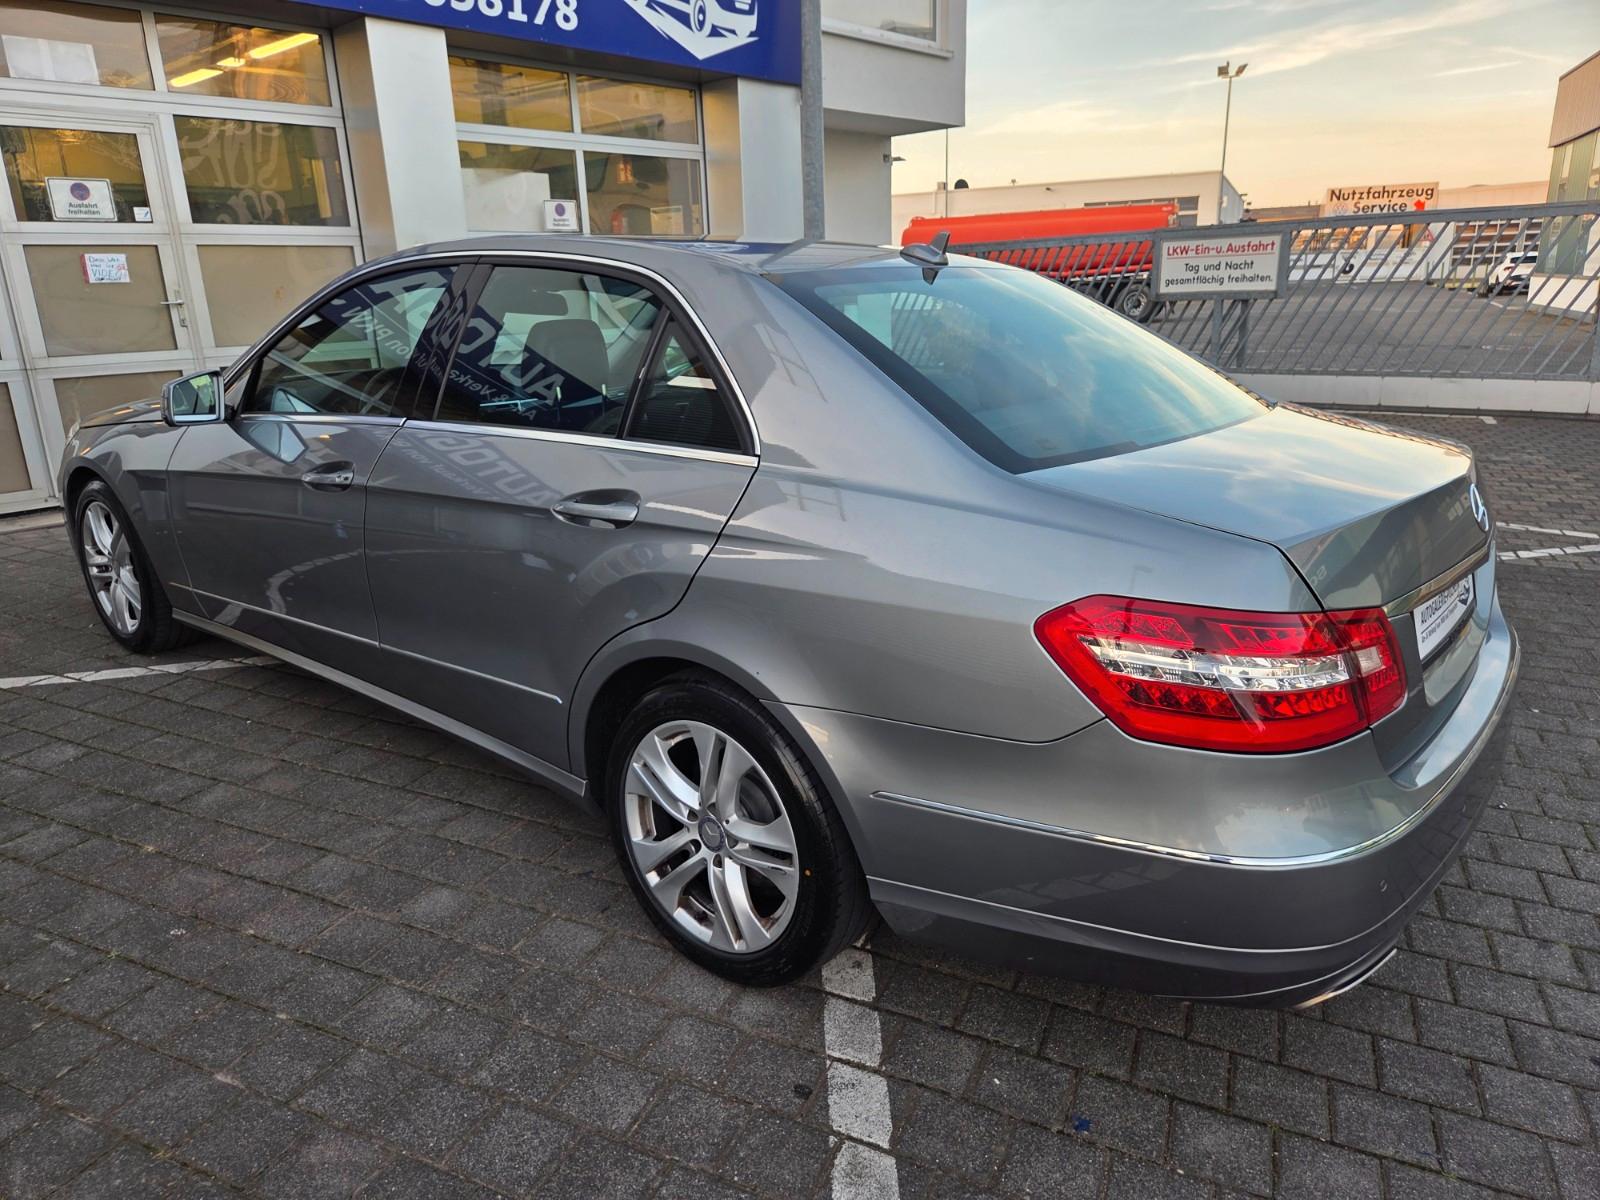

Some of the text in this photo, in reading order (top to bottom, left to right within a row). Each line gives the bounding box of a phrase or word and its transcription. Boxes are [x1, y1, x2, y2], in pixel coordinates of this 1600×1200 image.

[1329, 185, 1435, 202] Nutzfahrzeug
[1352, 199, 1408, 214] Service
[1226, 240, 1276, 254] Ausfahrt
[1184, 260, 1254, 275] Tag und Nacht
[1227, 273, 1273, 284] freihalten.
